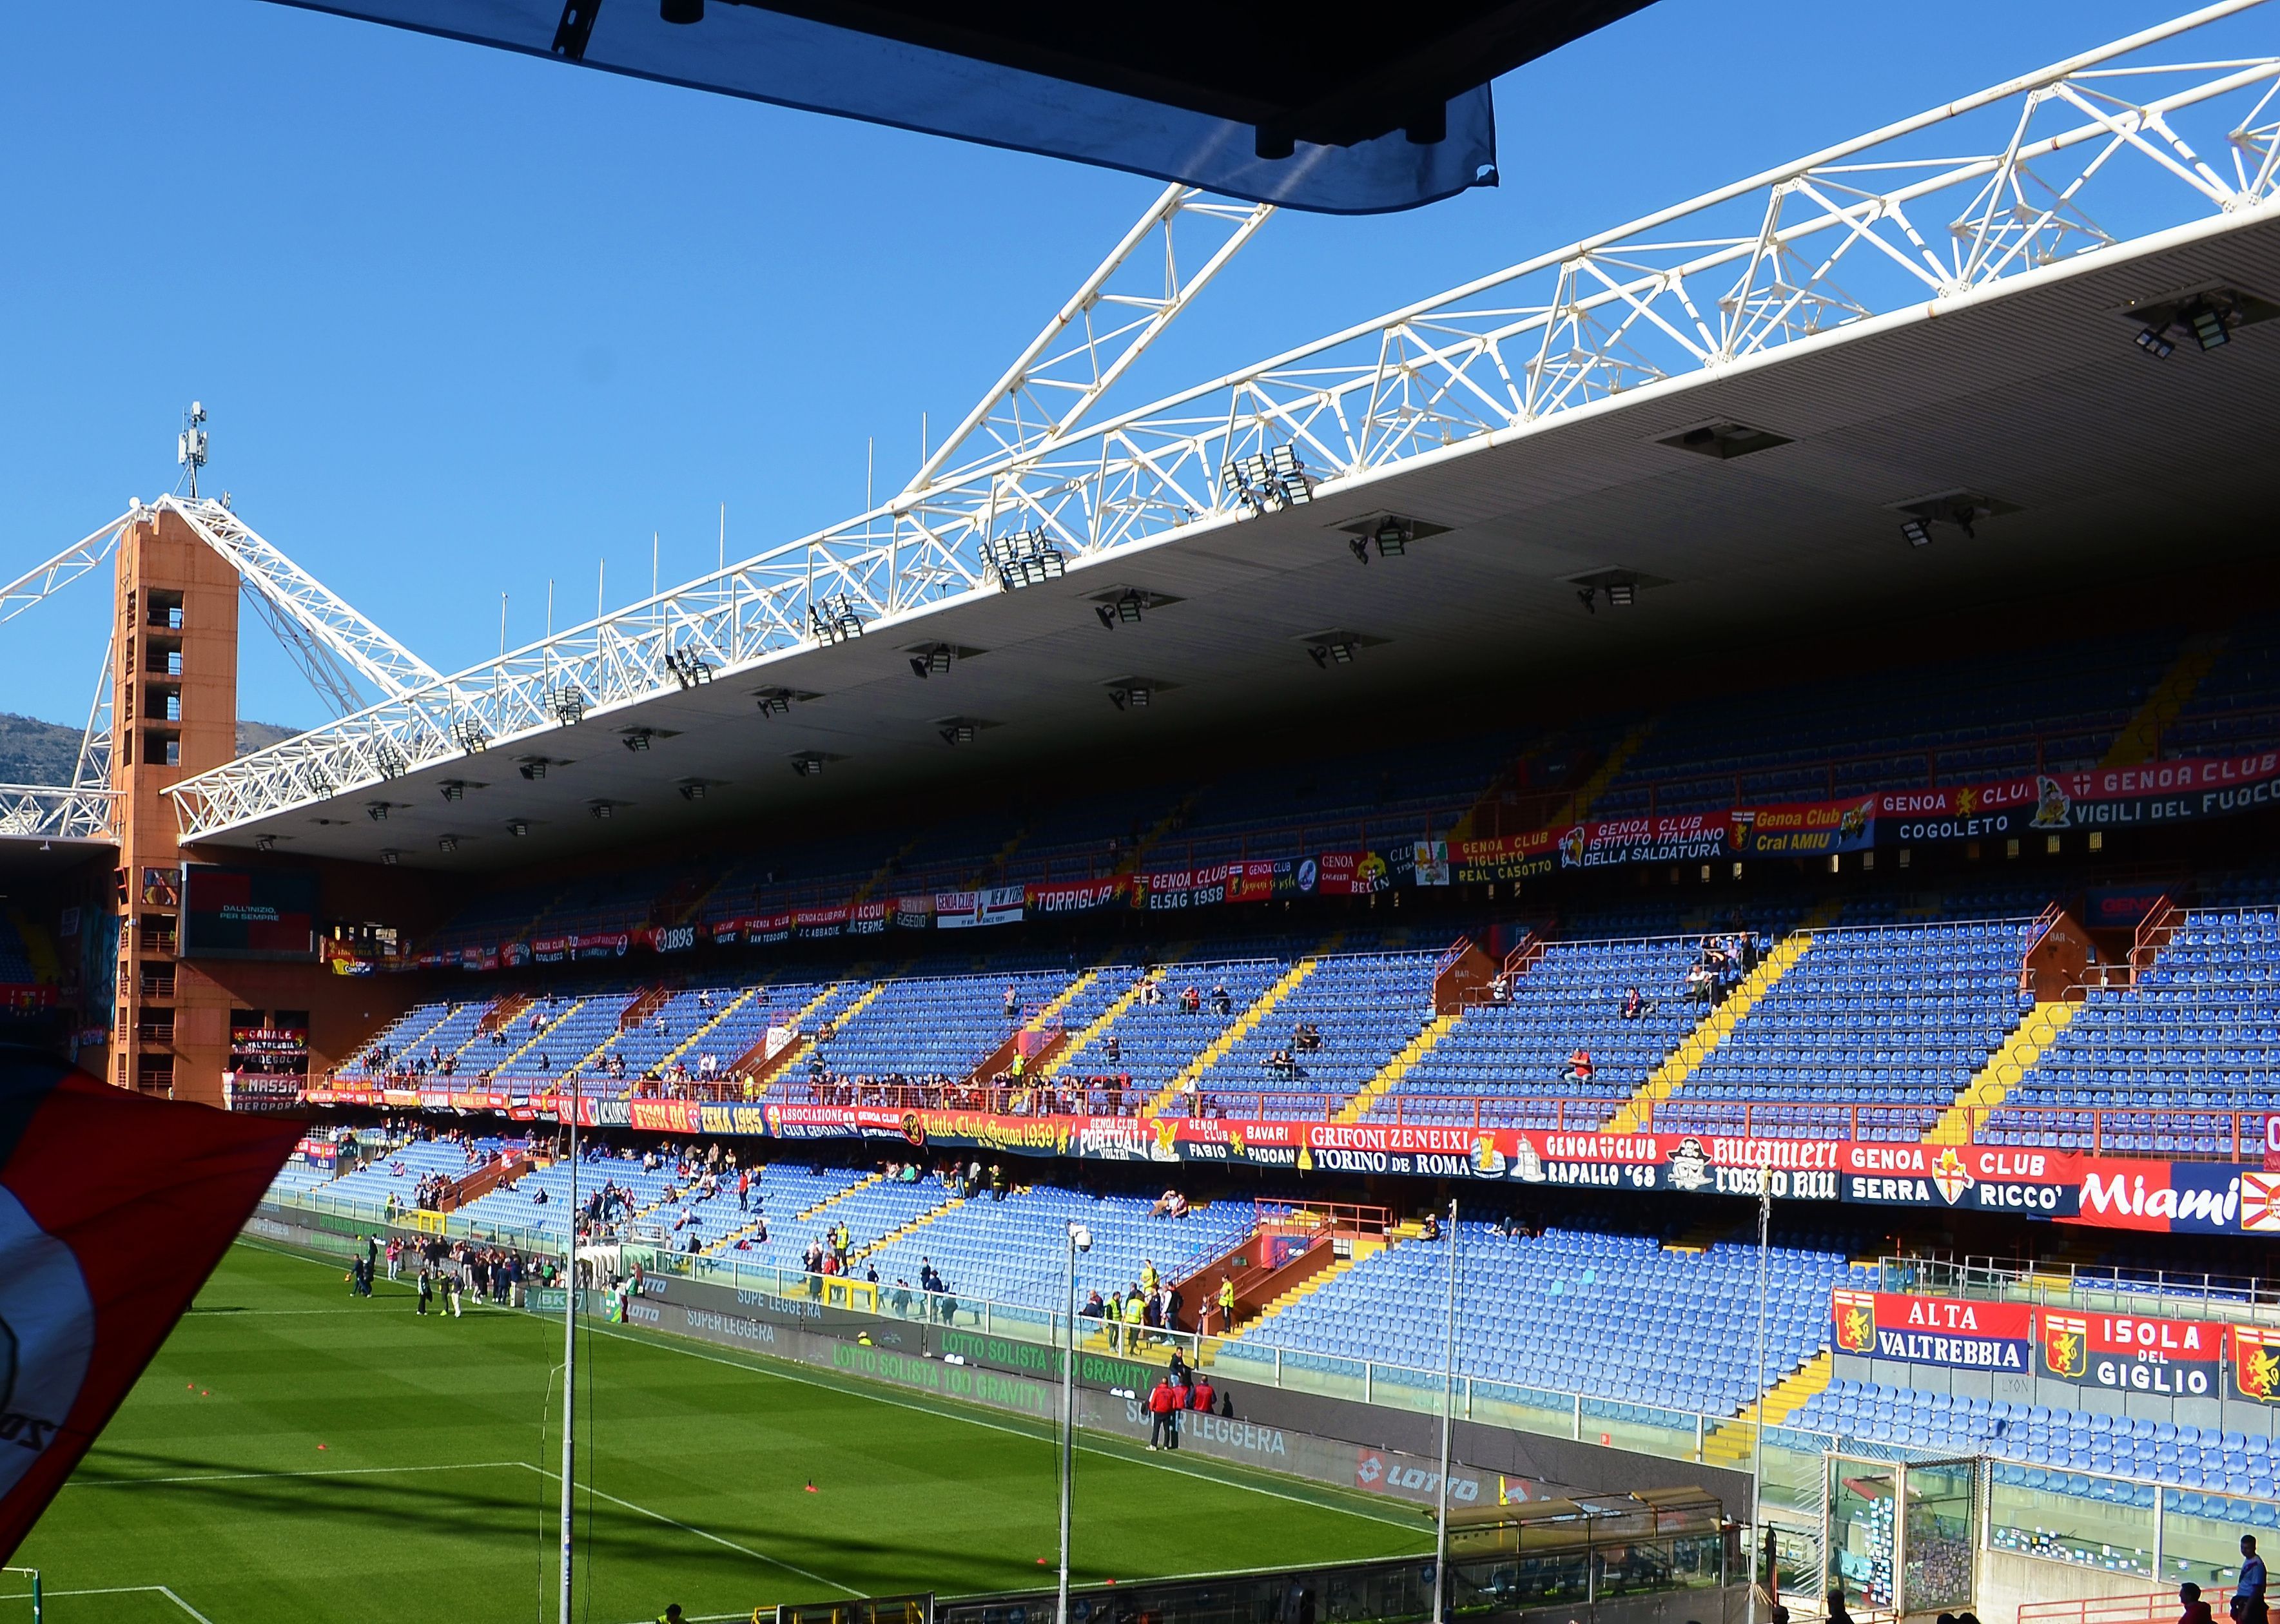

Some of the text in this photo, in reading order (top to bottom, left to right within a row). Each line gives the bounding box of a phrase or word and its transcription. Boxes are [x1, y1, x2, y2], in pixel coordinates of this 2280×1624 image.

[2104, 754, 2277, 791] GENOA CLUB
[1883, 794, 1946, 811] GENOA
[2076, 780, 2280, 824] VIGILI DEL FUOCO
[1598, 816, 1702, 836] GENOA CLUB
[1757, 808, 1840, 827] Genoa Club
[1900, 816, 2008, 838] COGOLETO
[1463, 831, 1548, 854] GENOA CLUB
[1590, 827, 1724, 851] ISTITUTO ITALIANO
[1757, 833, 1831, 851] Cral AMIU
[1322, 846, 1413, 867] GENOA CLU
[1467, 851, 1525, 867] TIGLIETO
[1584, 842, 1721, 866] DELLA SALDATURA
[1153, 872, 1191, 889] GENOA
[1197, 865, 1227, 884] CLUB
[1249, 862, 1291, 875] GENOA CLUB
[1459, 860, 1552, 882] REAL CASOTTO
[1351, 876, 1390, 893] BELIN
[938, 887, 1024, 909] GENOA CLUB NEW YOR
[1038, 885, 1113, 911] TORRIGLIA
[1151, 893, 1187, 909] ELSAG
[1194, 885, 1223, 905] 1988
[223, 905, 276, 914] DALL'INIZIO,
[797, 911, 816, 922] GENOA
[817, 909, 833, 922] CLUB
[857, 904, 884, 919] ACQUI
[897, 913, 926, 928] EUSEBIO
[753, 916, 789, 929] GENOA CLUB
[857, 919, 884, 934] TERME
[536, 940, 564, 950] GENOA CLUB
[667, 927, 694, 949] 1893
[750, 931, 788, 943] SAN TEODORO
[2050, 933, 2065, 942] BAR
[1455, 970, 1469, 978] BAR
[249, 1030, 291, 1039] CANALE
[248, 1079, 297, 1093] MASSA
[559, 1099, 585, 1122] GENA
[700, 1107, 763, 1134] ZENA 1995
[781, 1108, 843, 1122] ASSOCIAZIONE
[858, 1111, 899, 1124] GENOA CLUB
[783, 1124, 805, 1136] CLUB
[921, 1114, 955, 1137] Little
[955, 1116, 986, 1139] Club
[985, 1119, 1022, 1145] Genoa
[1024, 1123, 1055, 1148] 1959
[1090, 1118, 1138, 1130] GENOA CLUB
[1189, 1119, 1289, 1141] GENOA BAVARI
[1080, 1128, 1149, 1159] PORTUALI
[1205, 1130, 1229, 1141] CLUB
[1311, 1126, 1468, 1150] GRIFONI ZENEIXI
[1099, 1148, 1130, 1160] VOLTRI
[1189, 1143, 1295, 1163] FABIO PADOAN
[1546, 1135, 1657, 1160] GENOA CLUB
[1315, 1149, 1470, 1176] TORINO DE ROMA
[1851, 1148, 2045, 1177] GENOA CLUB
[1548, 1162, 1619, 1186] RAPALLO
[1852, 1177, 2062, 1210] SERRA RICCO'
[2079, 1173, 2240, 1226] Miami
[1907, 1301, 1978, 1330] ALTA
[687, 1310, 774, 1344] SUPER LEGGERA
[2103, 1319, 2200, 1350] ISOLA
[941, 1331, 985, 1358] LOTTO
[988, 1340, 1047, 1371] SOLISTA
[1083, 1357, 1152, 1390] GRAVITY
[1878, 1331, 2021, 1368] VALTREBBIA
[2138, 1349, 2168, 1365] DEL
[833, 1344, 1047, 1411] LOTTO SOLISTA 100 GRAVITY
[2002, 1379, 2029, 1393] LYON
[2097, 1361, 2207, 1395] GIGLIO
[1193, 1414, 1285, 1456] LEGGERA
